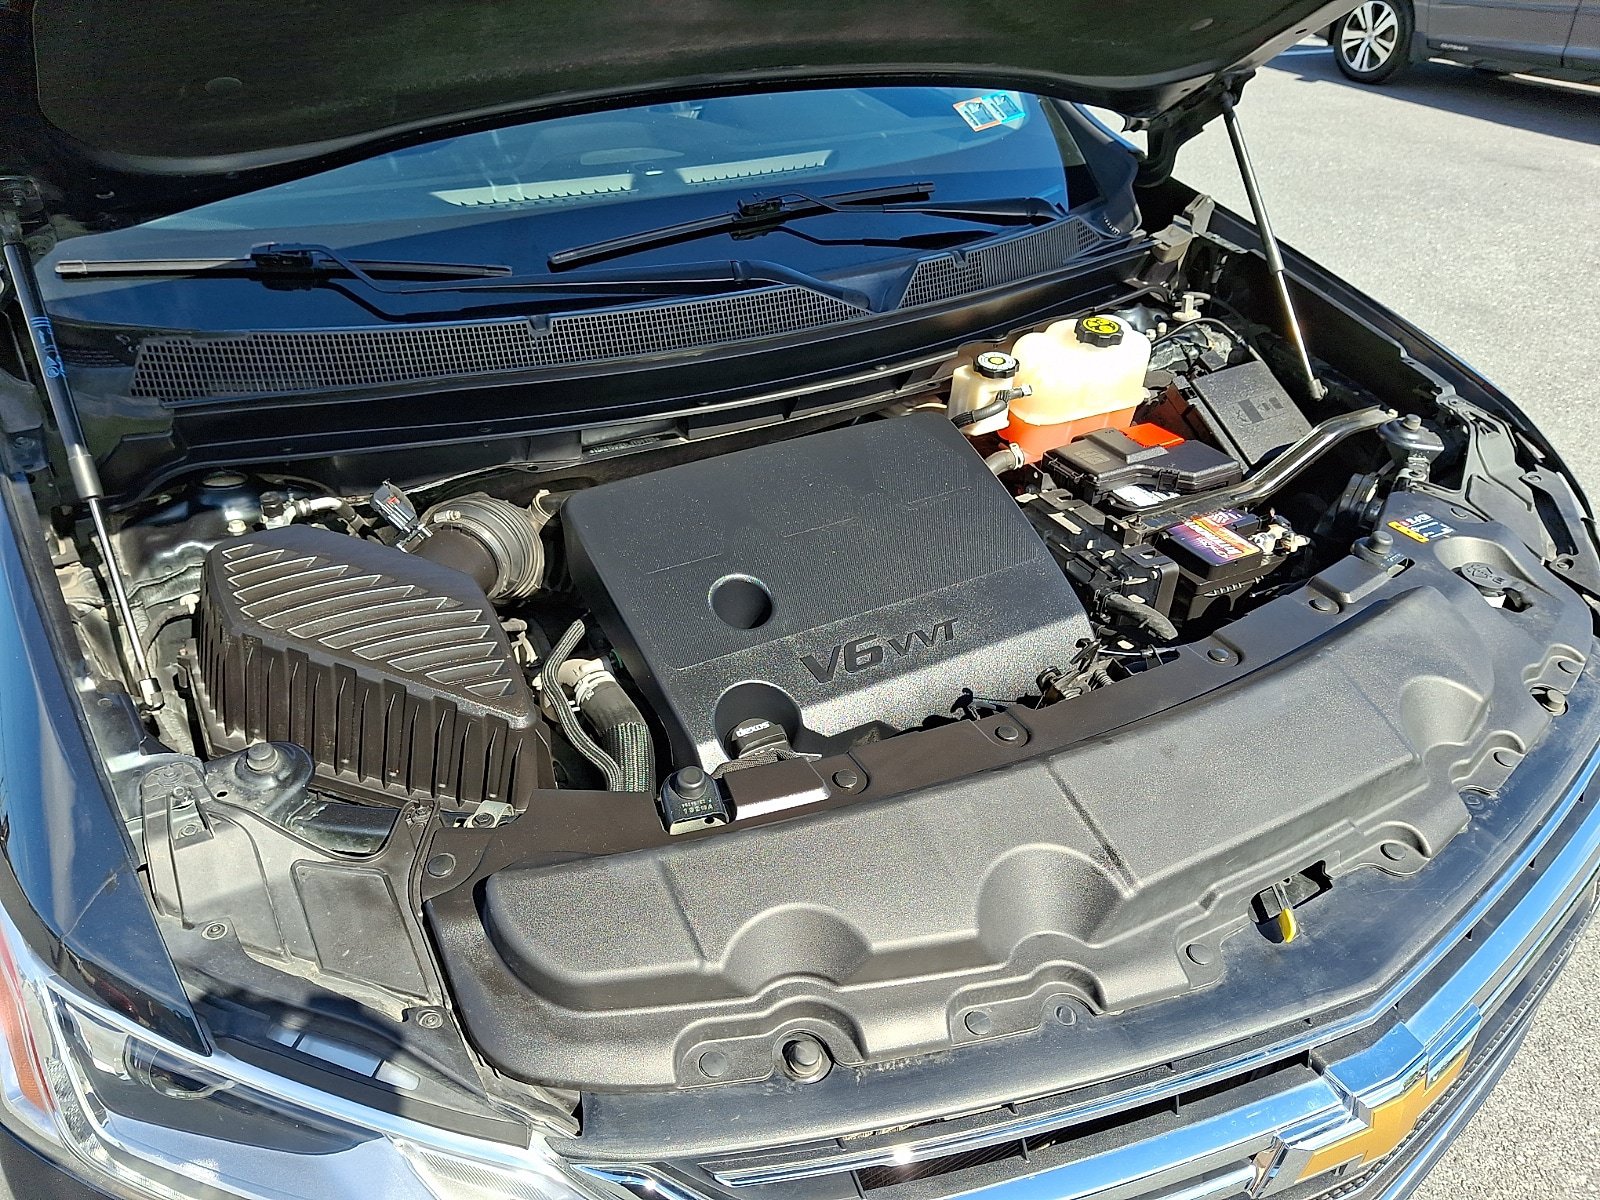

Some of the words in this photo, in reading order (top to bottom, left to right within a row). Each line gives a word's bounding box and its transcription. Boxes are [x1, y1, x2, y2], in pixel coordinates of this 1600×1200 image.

[800, 634, 883, 684] V6
[888, 617, 958, 657] VVT
[735, 721, 771, 738] dexos
